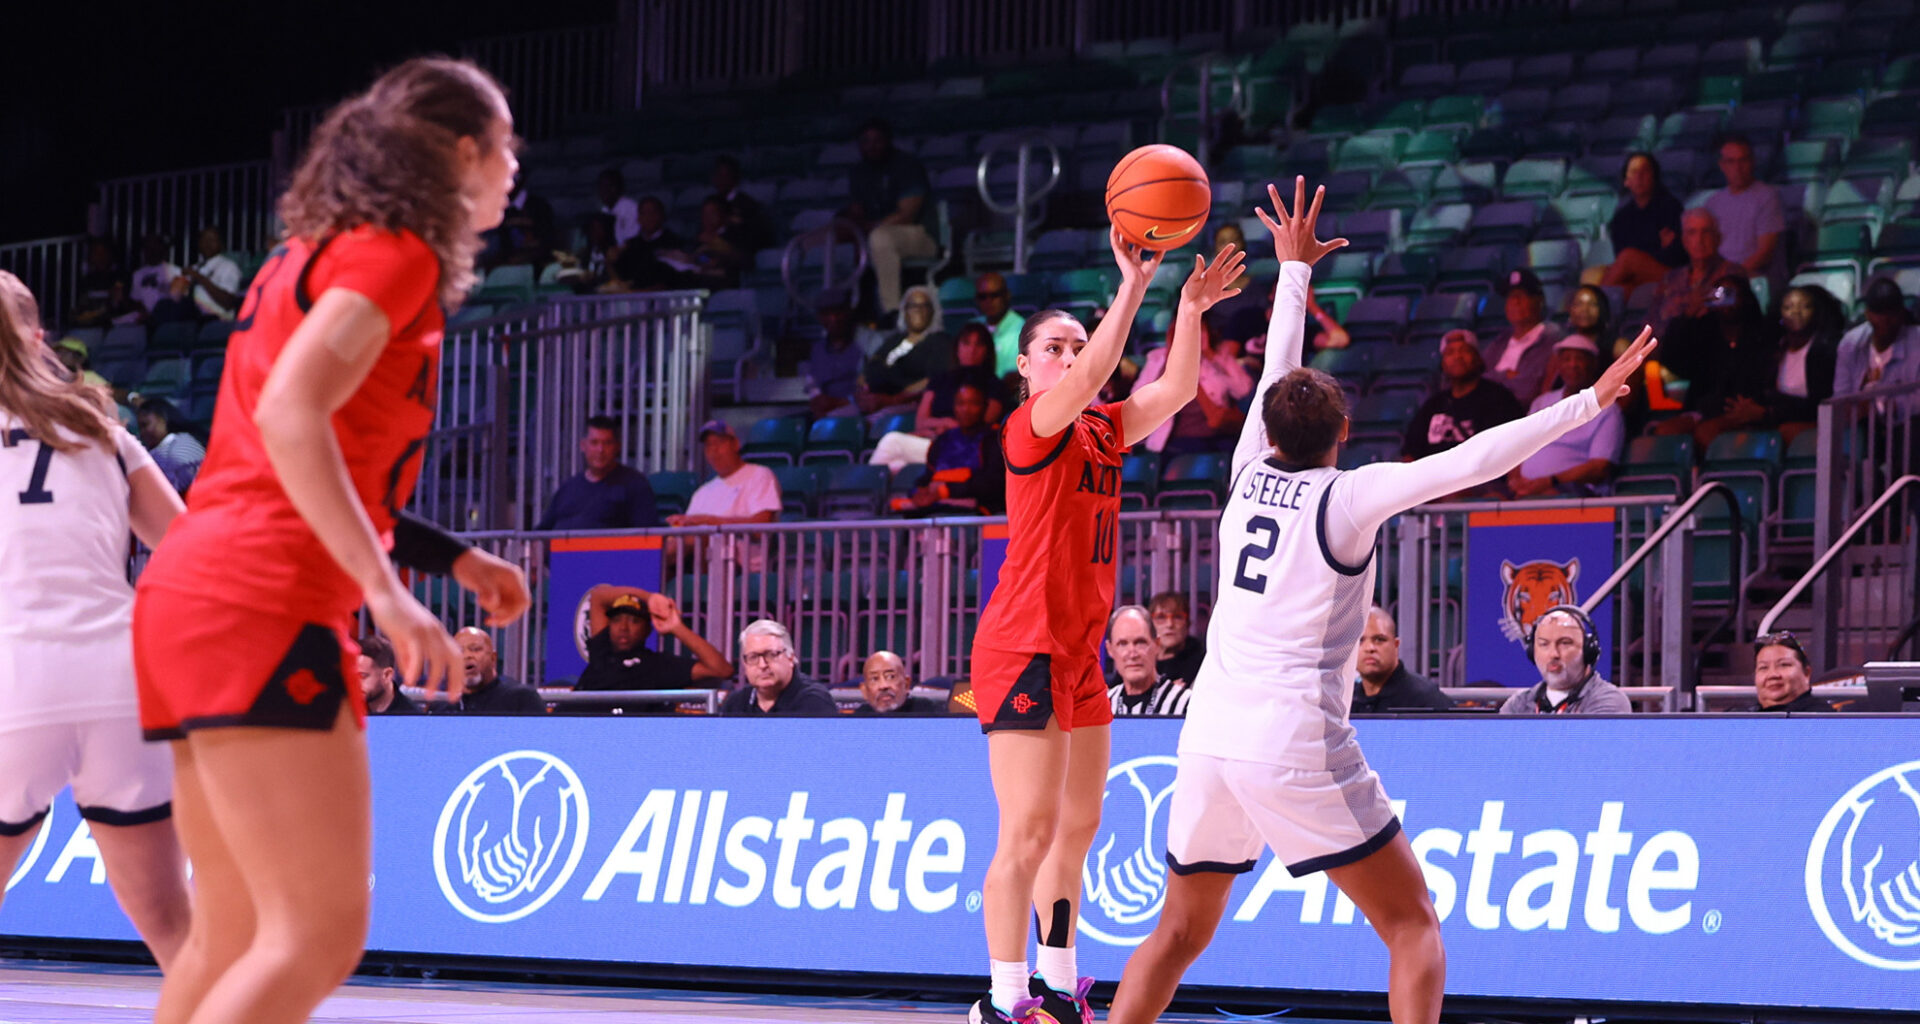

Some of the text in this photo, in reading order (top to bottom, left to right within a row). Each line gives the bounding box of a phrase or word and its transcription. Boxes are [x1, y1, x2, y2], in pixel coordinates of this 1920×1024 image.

[1, 428, 54, 504] 7
[1243, 471, 1310, 510] STEELE
[1091, 508, 1114, 564] 10
[1233, 515, 1280, 595] 2
[582, 789, 966, 913] Allstate
[1233, 799, 1700, 934] Astate
